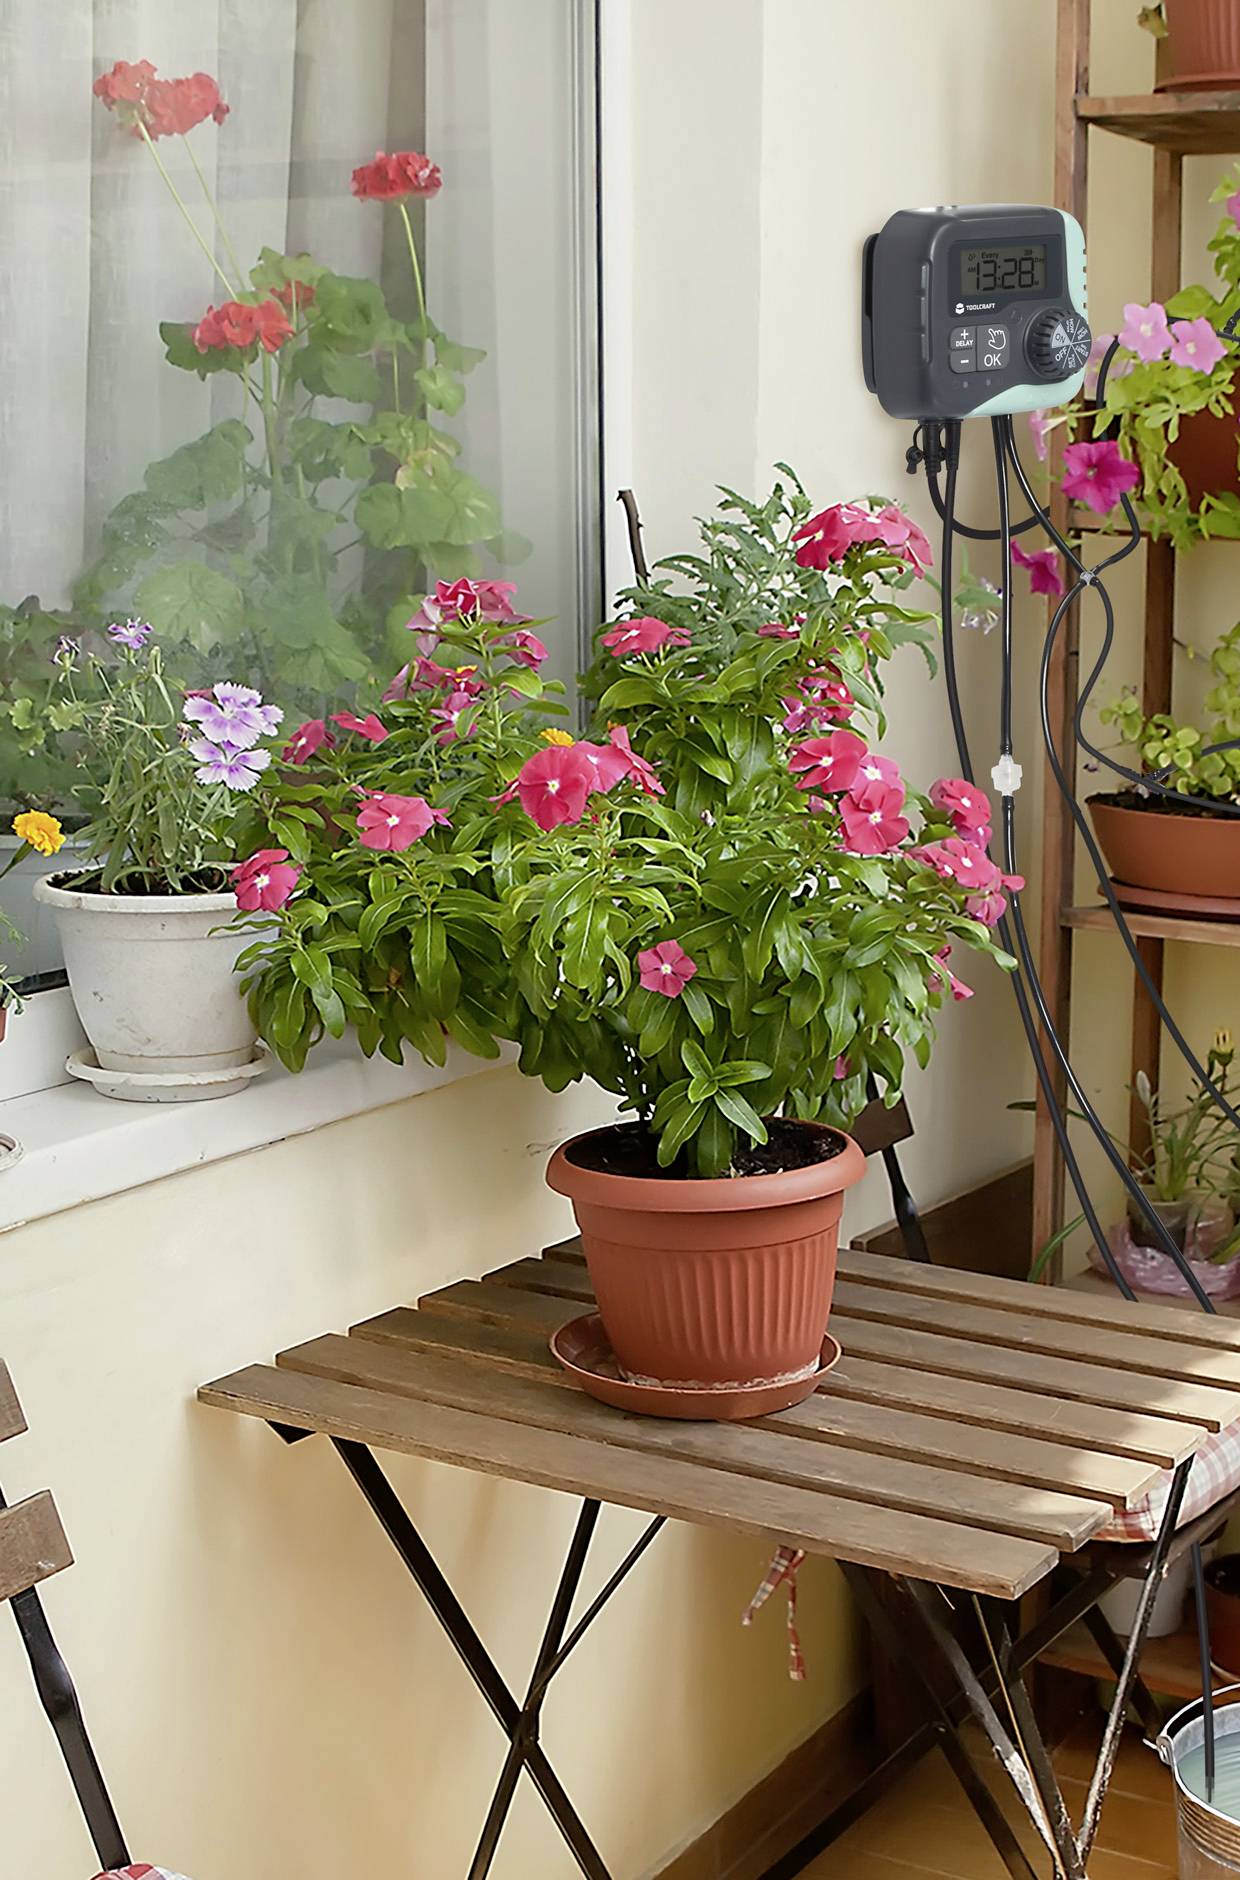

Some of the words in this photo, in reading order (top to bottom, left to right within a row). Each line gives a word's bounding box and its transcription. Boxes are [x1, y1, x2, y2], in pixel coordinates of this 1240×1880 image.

[977, 257, 1034, 291] 13:28
[1056, 334, 1065, 343] ON
[984, 354, 1001, 366] OK
[1055, 347, 1067, 361] OFF
